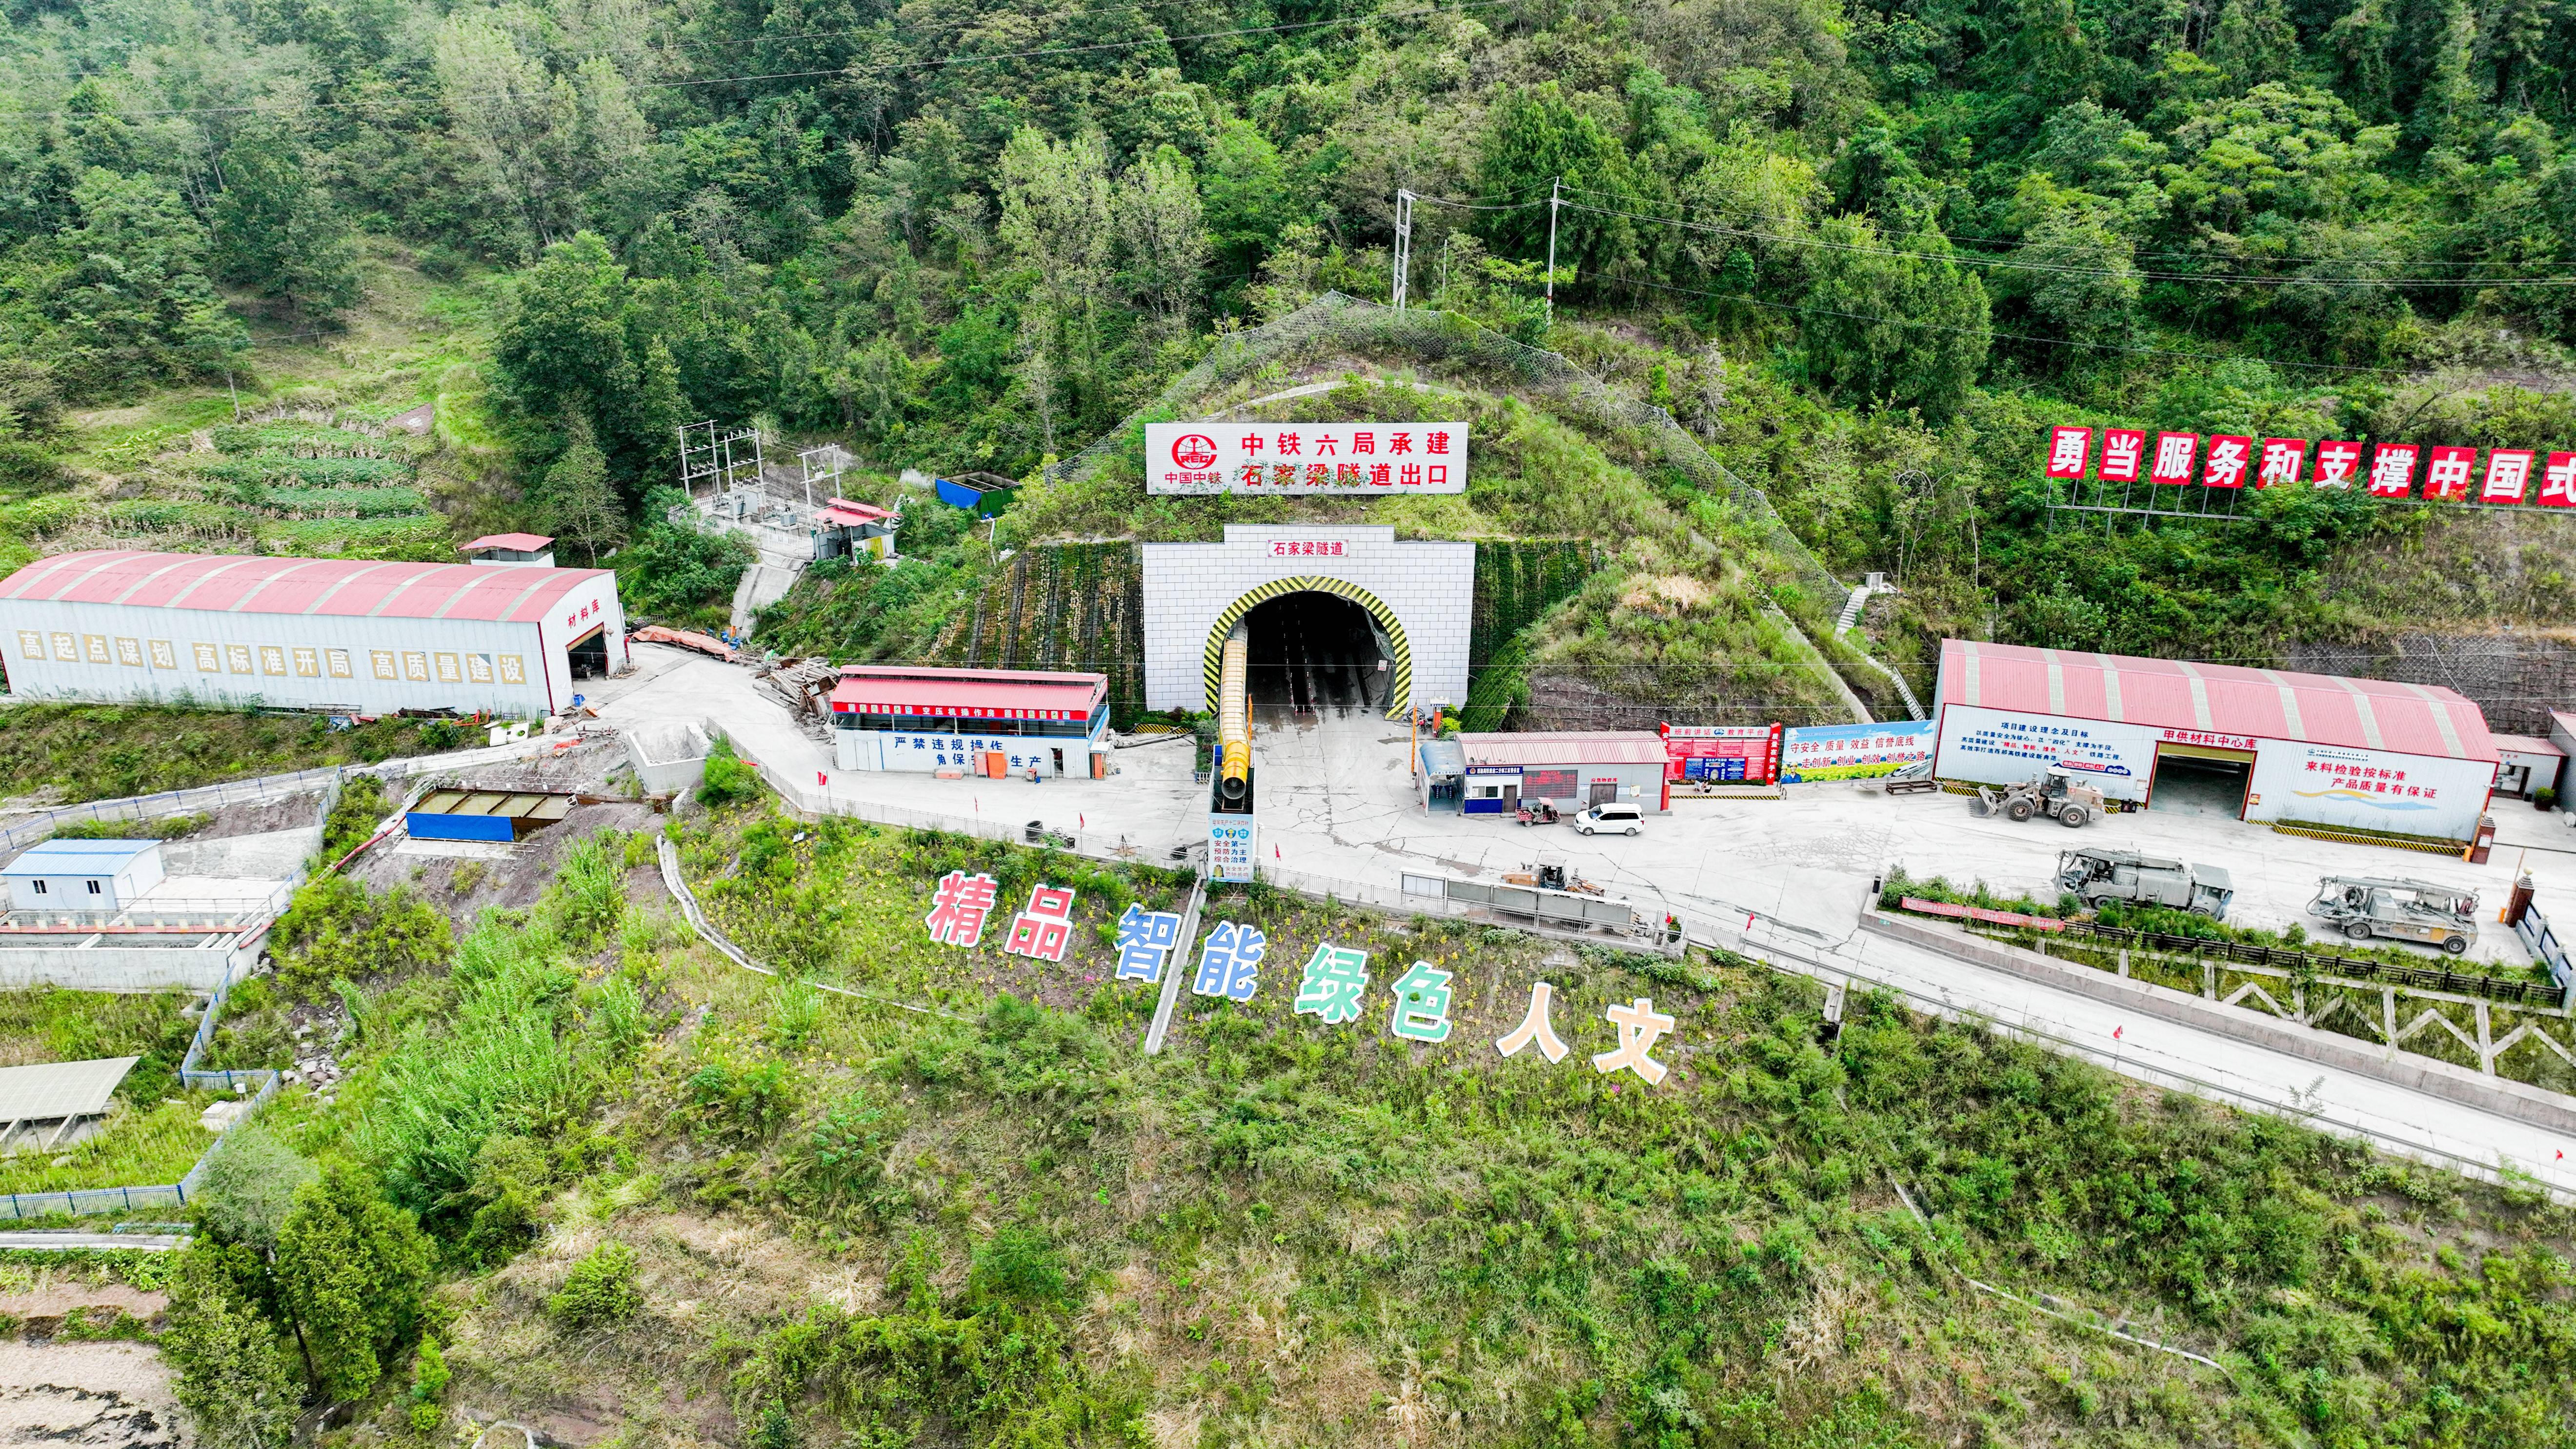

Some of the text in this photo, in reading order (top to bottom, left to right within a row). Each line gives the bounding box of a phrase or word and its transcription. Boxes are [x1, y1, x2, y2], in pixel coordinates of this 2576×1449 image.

[1241, 431, 1450, 457] 中铁六局承建
[1165, 471, 1221, 484] 中国中铁
[1274, 541, 1343, 556] 石家梁隧道
[567, 599, 600, 628] 材料库
[20, 632, 524, 682] 高起点谋划 高标准开局 高质量建设
[922, 706, 995, 717] 空压机操作房
[1674, 727, 1764, 736] 班前讲话 教育平台
[2001, 722, 2089, 738] 项目建设理念及目标
[894, 736, 1003, 751] 严禁违规操作
[1790, 736, 1914, 754] 守安全 质量 效益 信誉底线
[2163, 730, 2258, 749] 甲供材料中心库
[1767, 733, 1779, 779] 质量在你手中
[1801, 751, 1926, 769] 走创新 创业 创效 创誉之路
[2305, 761, 2407, 782] 来料检验按标准
[2331, 778, 2437, 799] 产品质量有保证
[928, 872, 1673, 1083] 精品 智能 绿色 人文
